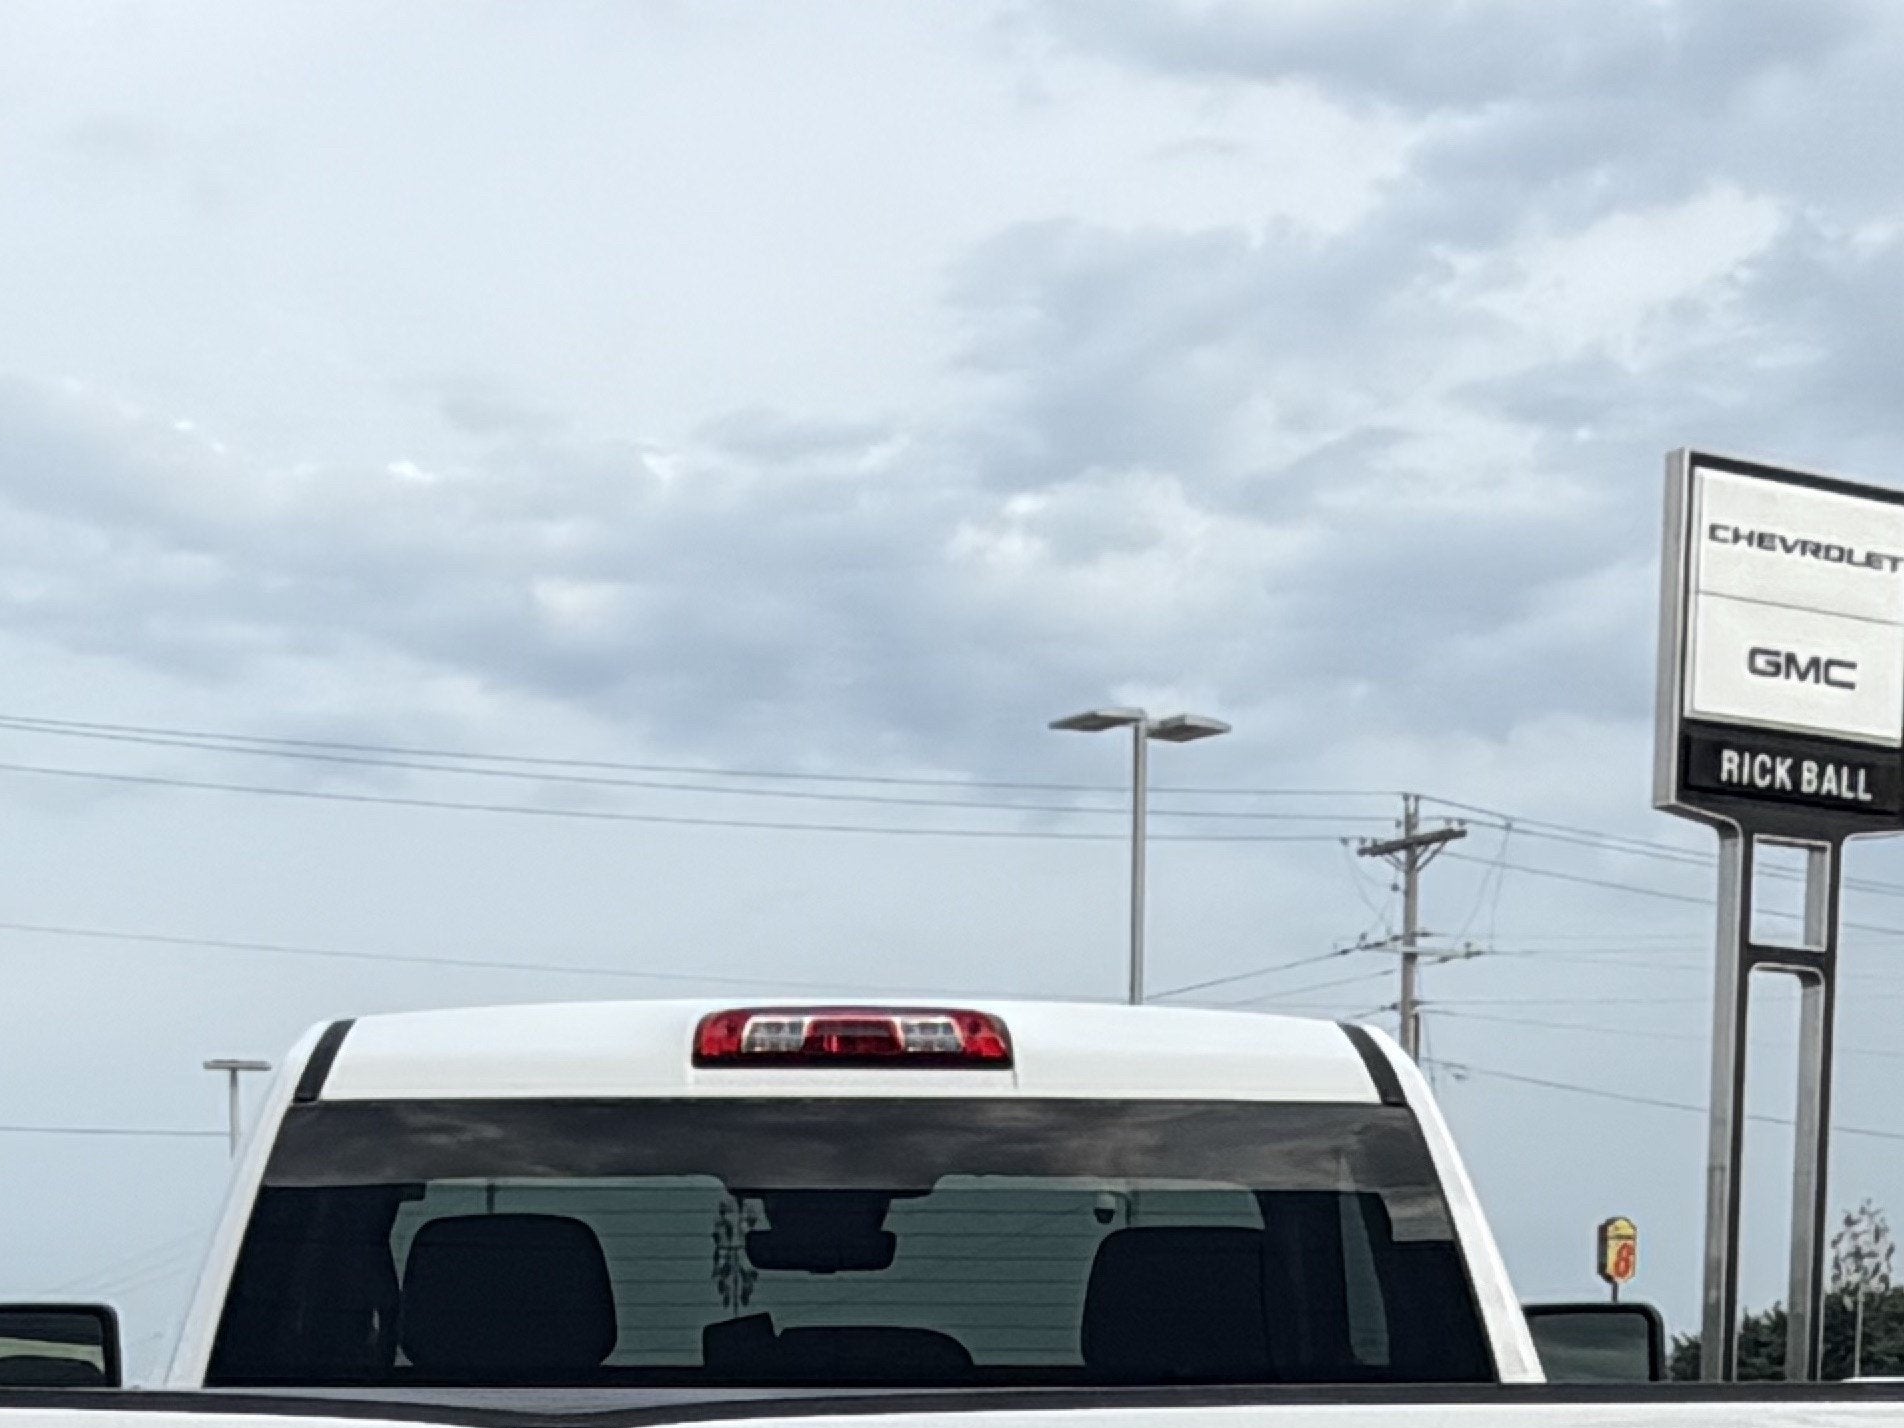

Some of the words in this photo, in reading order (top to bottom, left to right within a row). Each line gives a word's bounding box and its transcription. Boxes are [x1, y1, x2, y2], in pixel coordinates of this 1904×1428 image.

[1708, 523, 1904, 573] CHEVROLET
[1748, 647, 1857, 690] GMC
[1720, 749, 1793, 792] RICK
[1801, 759, 1872, 801] BALL
